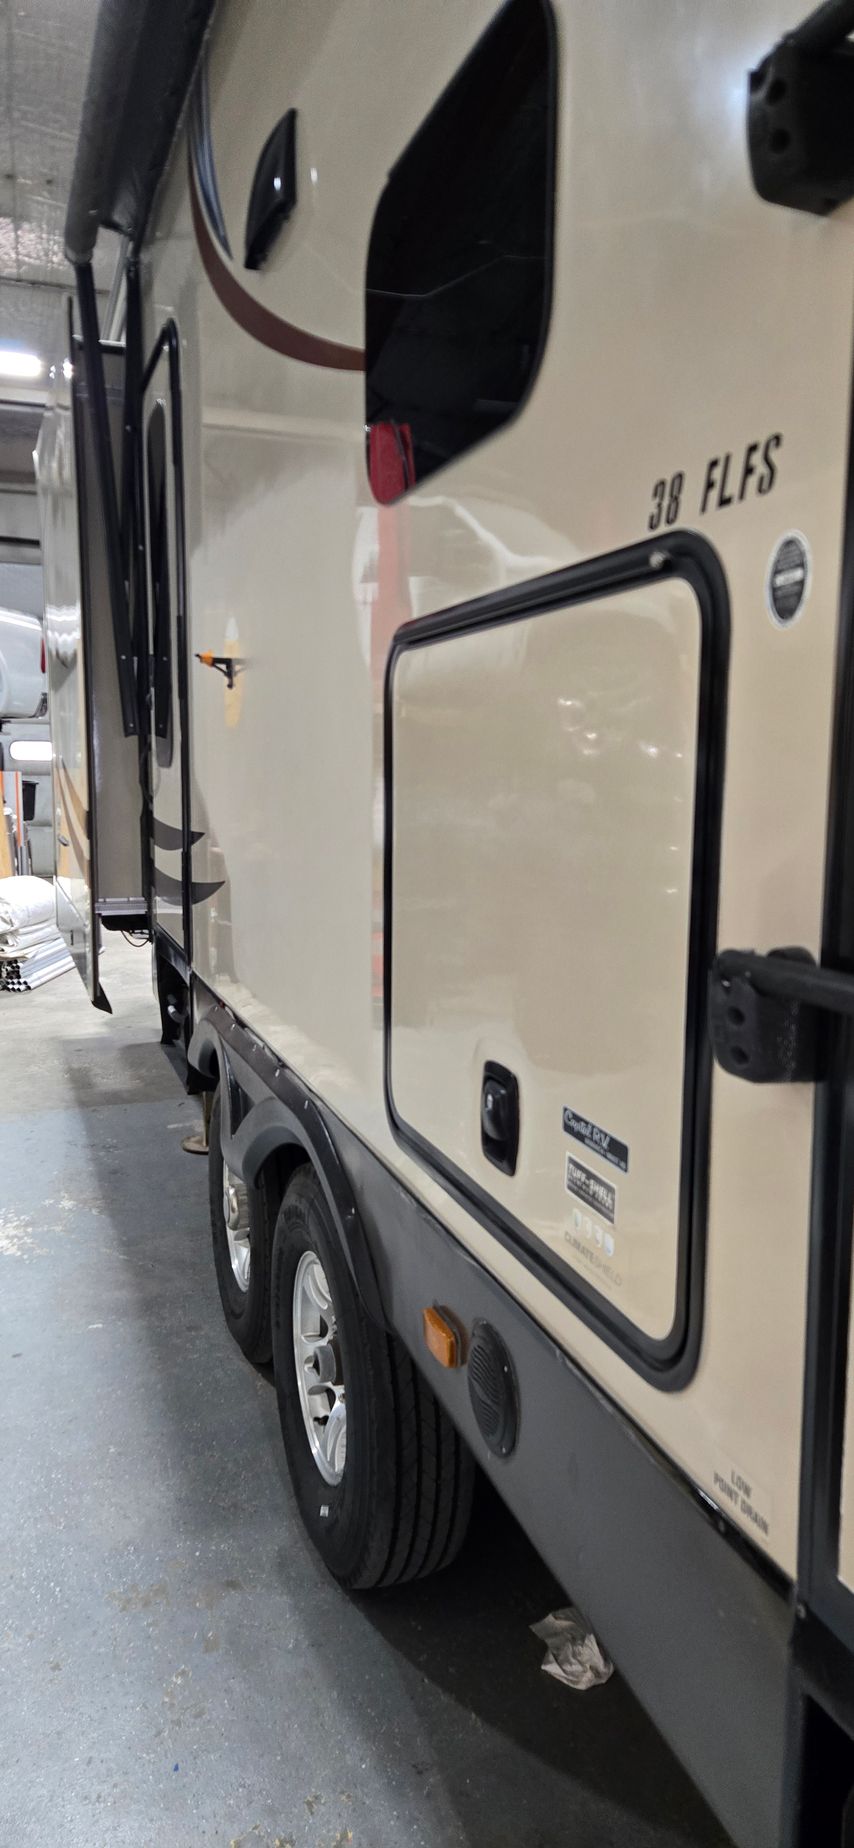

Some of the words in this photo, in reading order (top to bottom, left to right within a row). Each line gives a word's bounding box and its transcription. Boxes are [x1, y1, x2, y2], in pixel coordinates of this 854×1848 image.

[648, 470, 685, 531] 38
[700, 431, 783, 515] FLFS
[592, 1127, 611, 1150] RV
[713, 1471, 740, 1505] POINT
[740, 1497, 769, 1536] DRAIN
[730, 1469, 752, 1498] LOW
